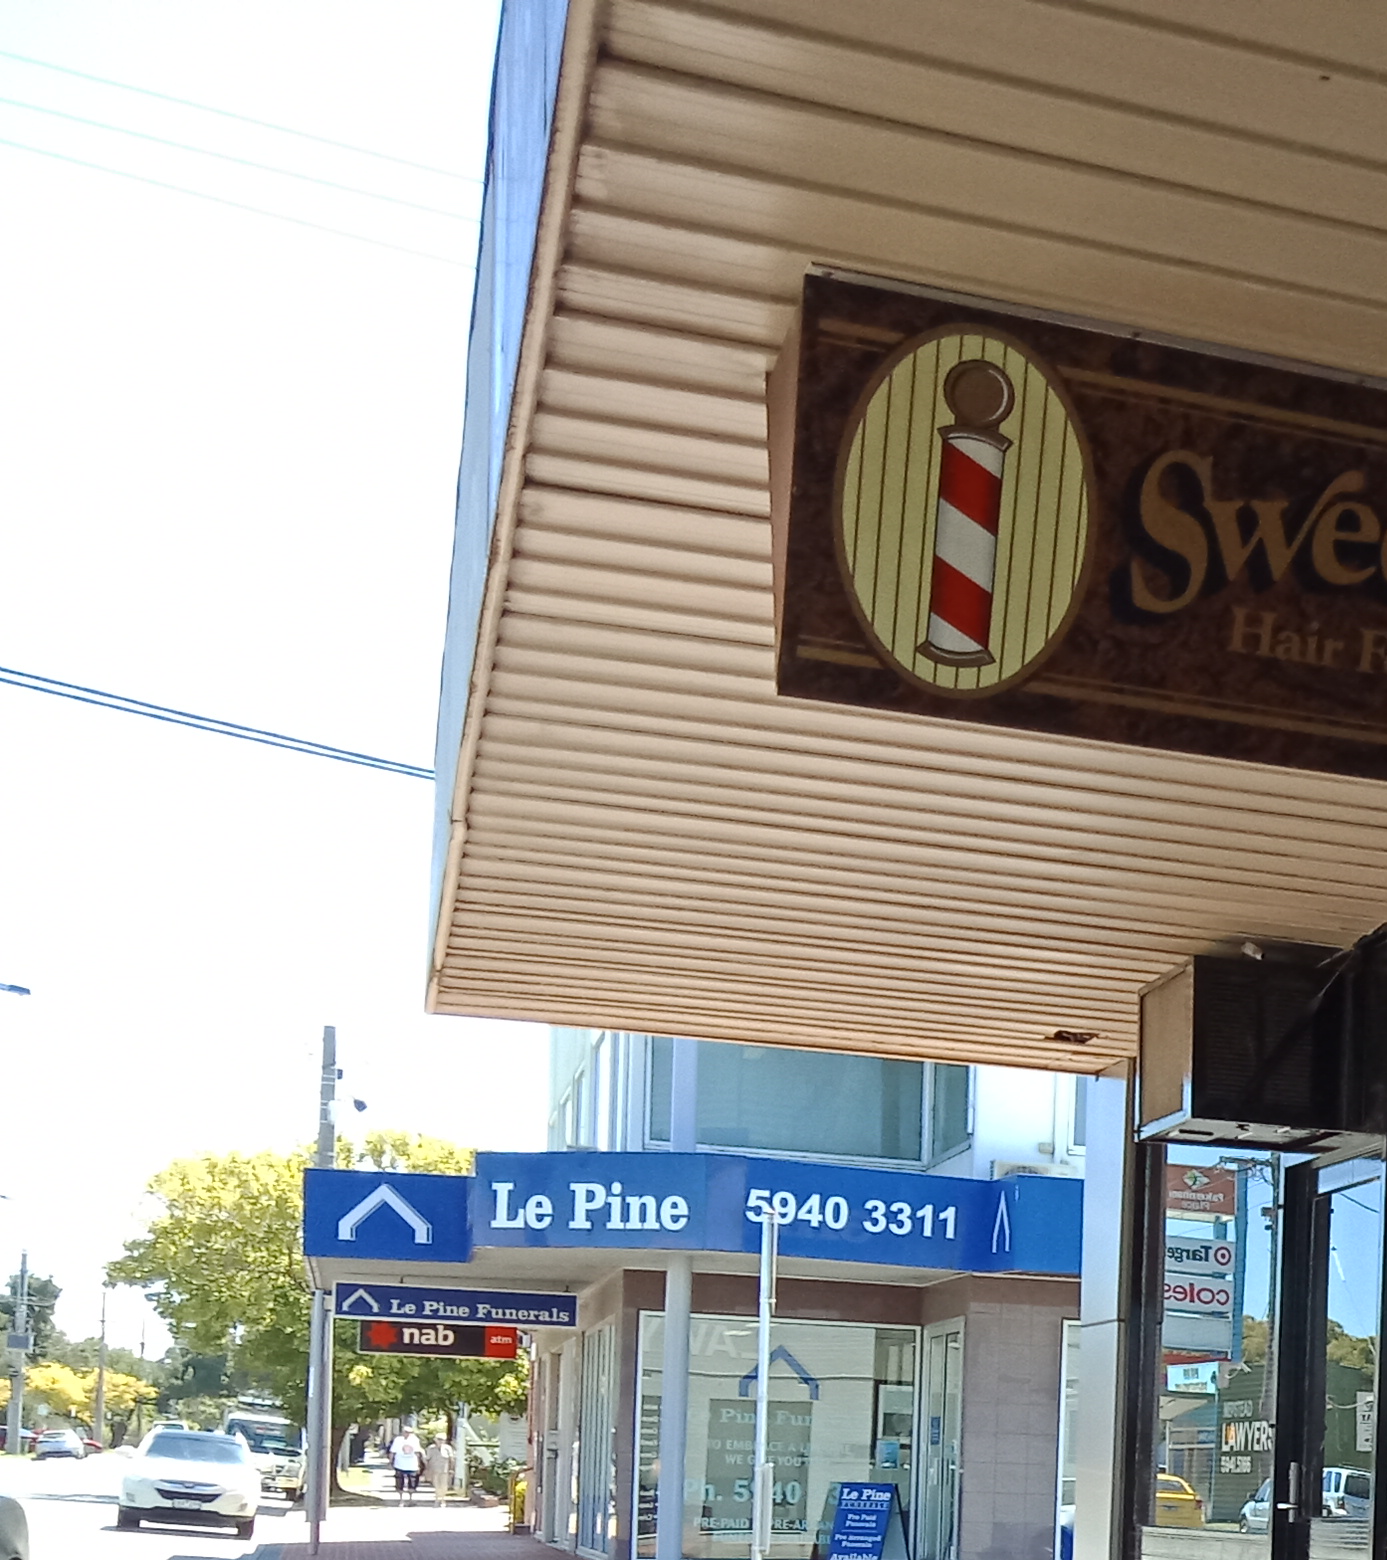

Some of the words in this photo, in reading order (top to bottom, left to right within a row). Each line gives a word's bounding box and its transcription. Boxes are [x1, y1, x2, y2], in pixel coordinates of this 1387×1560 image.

[1226, 604, 1343, 667] Hair
[490, 1182, 553, 1229] Le
[568, 1182, 690, 1231] Pine
[745, 1188, 849, 1230] 5940
[861, 1199, 957, 1239] 3311
[390, 1299, 416, 1315] Le
[423, 1300, 470, 1317] Pine
[476, 1302, 570, 1323] Funerals
[402, 1325, 455, 1346] nab
[490, 1334, 513, 1345] atm
[841, 1487, 859, 1500] Le
[861, 1488, 891, 1501] Pine
